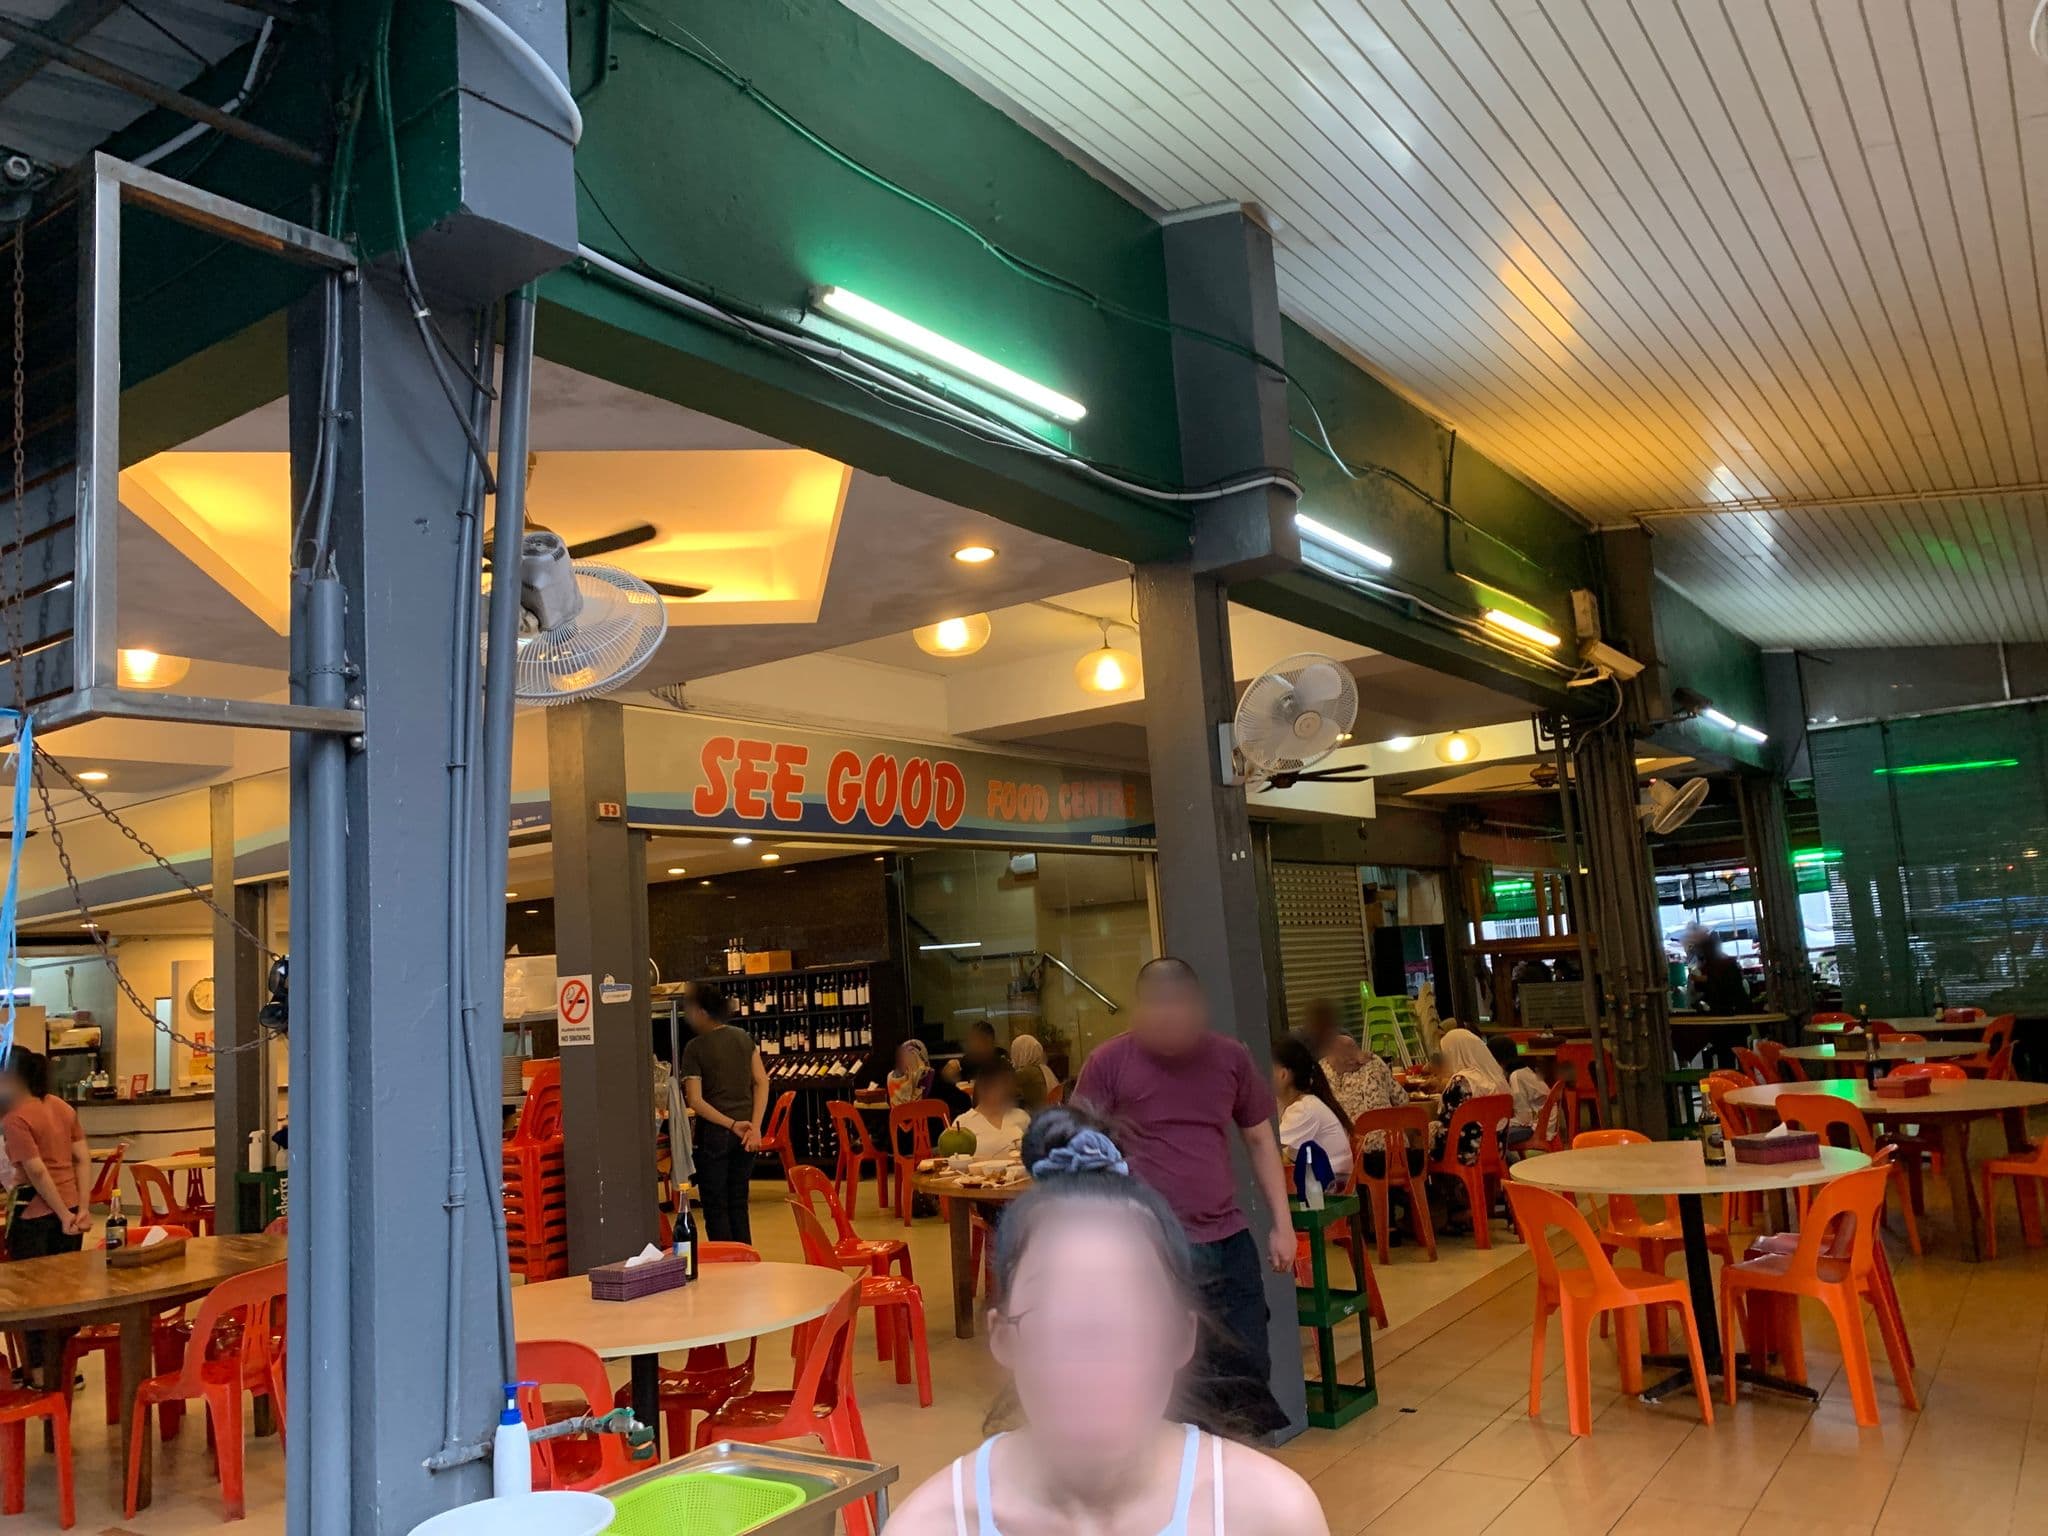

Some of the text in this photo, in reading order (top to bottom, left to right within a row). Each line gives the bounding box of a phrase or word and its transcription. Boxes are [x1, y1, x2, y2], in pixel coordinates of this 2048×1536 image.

[693, 736, 1136, 831] SEE GOOD FOOD CENTRE
